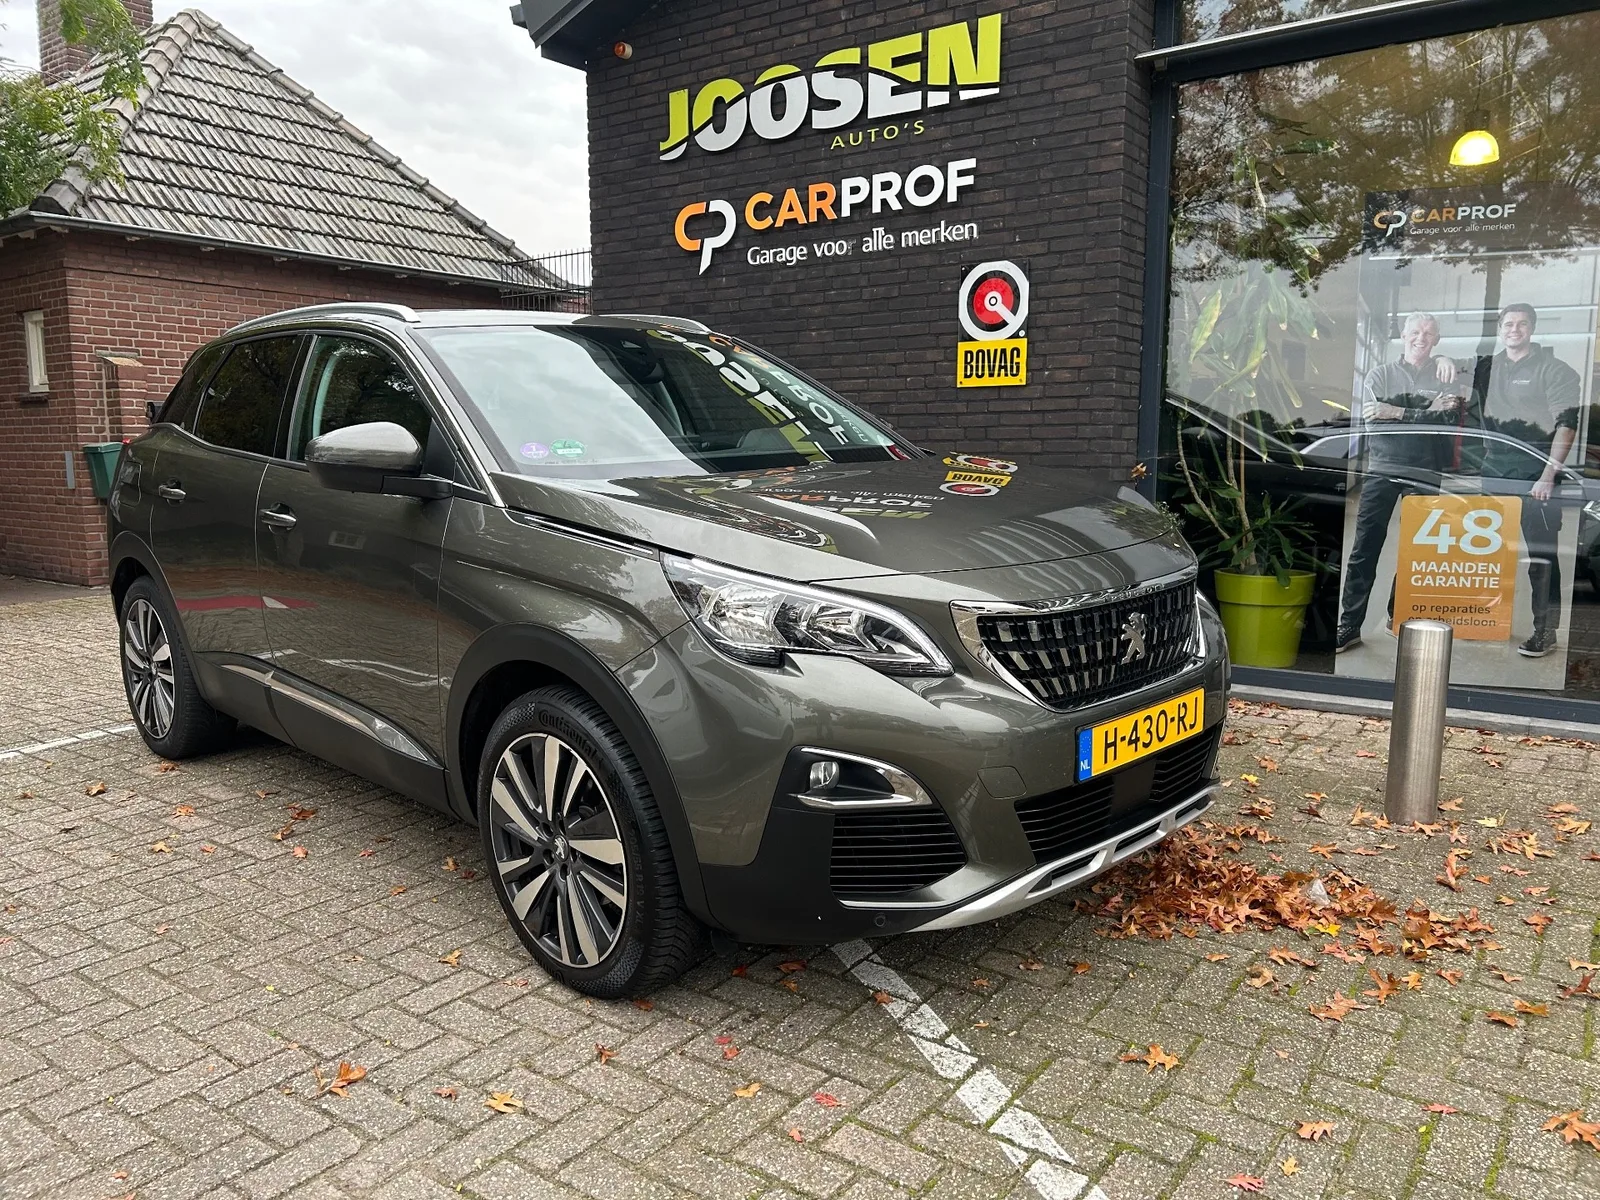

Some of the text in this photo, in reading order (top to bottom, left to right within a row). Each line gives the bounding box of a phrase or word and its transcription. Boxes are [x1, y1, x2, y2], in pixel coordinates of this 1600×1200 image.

[659, 13, 1002, 161] JOOSEN
[830, 120, 925, 150] AUTO'S
[745, 158, 977, 230] CARPROF
[1411, 203, 1517, 223] CARPROF
[747, 245, 808, 266] Garage
[901, 220, 978, 248] merken
[1410, 223, 1516, 235] Garage voor alle merken
[963, 347, 1021, 379] BOVAG
[1412, 508, 1503, 556] 48
[1410, 575, 1500, 589] GARANTIE
[1411, 561, 1501, 574] MAANDEN
[1411, 603, 1491, 615] op reparaties
[1103, 696, 1198, 764] H-430-RJ
[1080, 760, 1090, 771] NL
